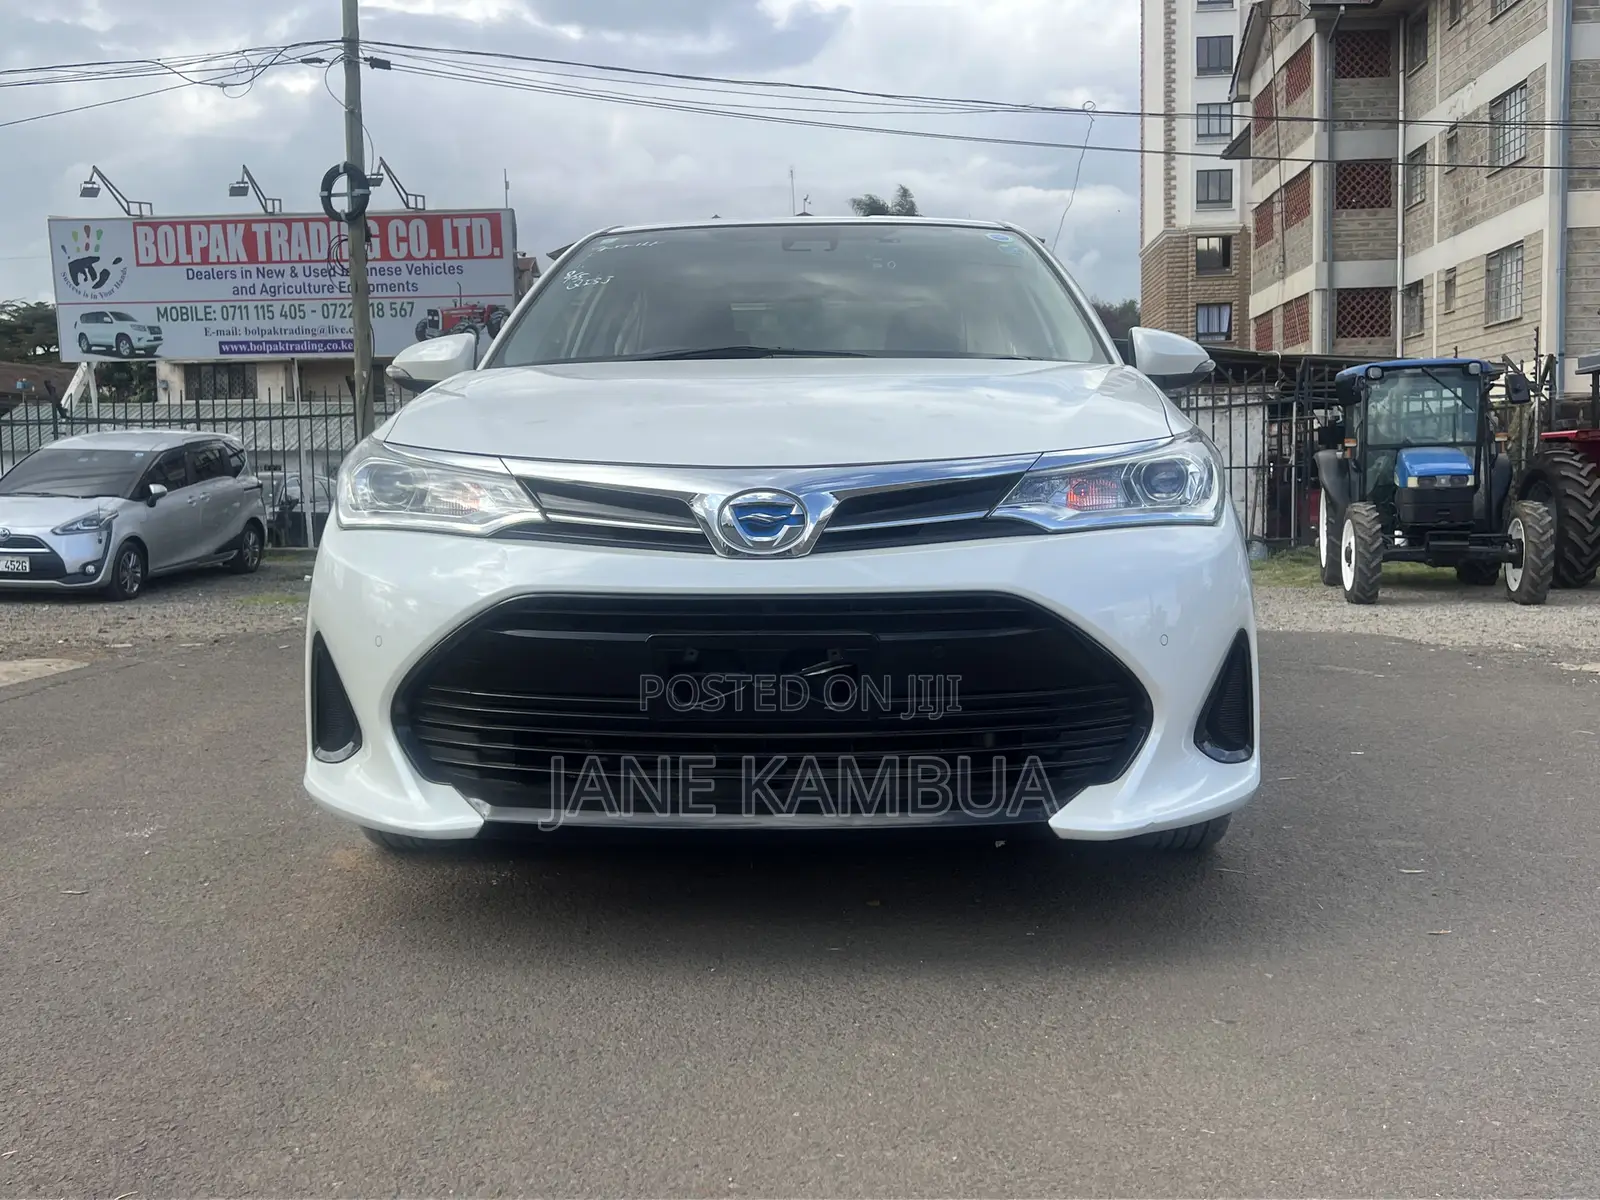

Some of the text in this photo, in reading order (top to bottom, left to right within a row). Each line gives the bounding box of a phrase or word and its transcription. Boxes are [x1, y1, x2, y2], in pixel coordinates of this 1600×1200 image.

[136, 223, 248, 264] BOLPAK
[388, 218, 437, 259] CO.
[442, 217, 500, 258] LTD.
[186, 268, 237, 280] Dealers
[241, 267, 252, 279] in
[256, 266, 285, 279] New
[289, 265, 299, 278] &
[303, 265, 336, 278] Used
[405, 263, 464, 276] Vehicles
[232, 283, 256, 295] and
[260, 281, 334, 297] Agriculture
[156, 305, 217, 322] MOBILE:
[221, 304, 249, 321] 0711
[254, 304, 275, 320] 115
[280, 303, 306, 320] 405
[369, 302, 385, 318] 18
[389, 301, 415, 318] 567
[204, 324, 354, 338] E-mail: bolpaktrading@live.c
[222, 340, 353, 354] www.bolpaktrading.co.ke
